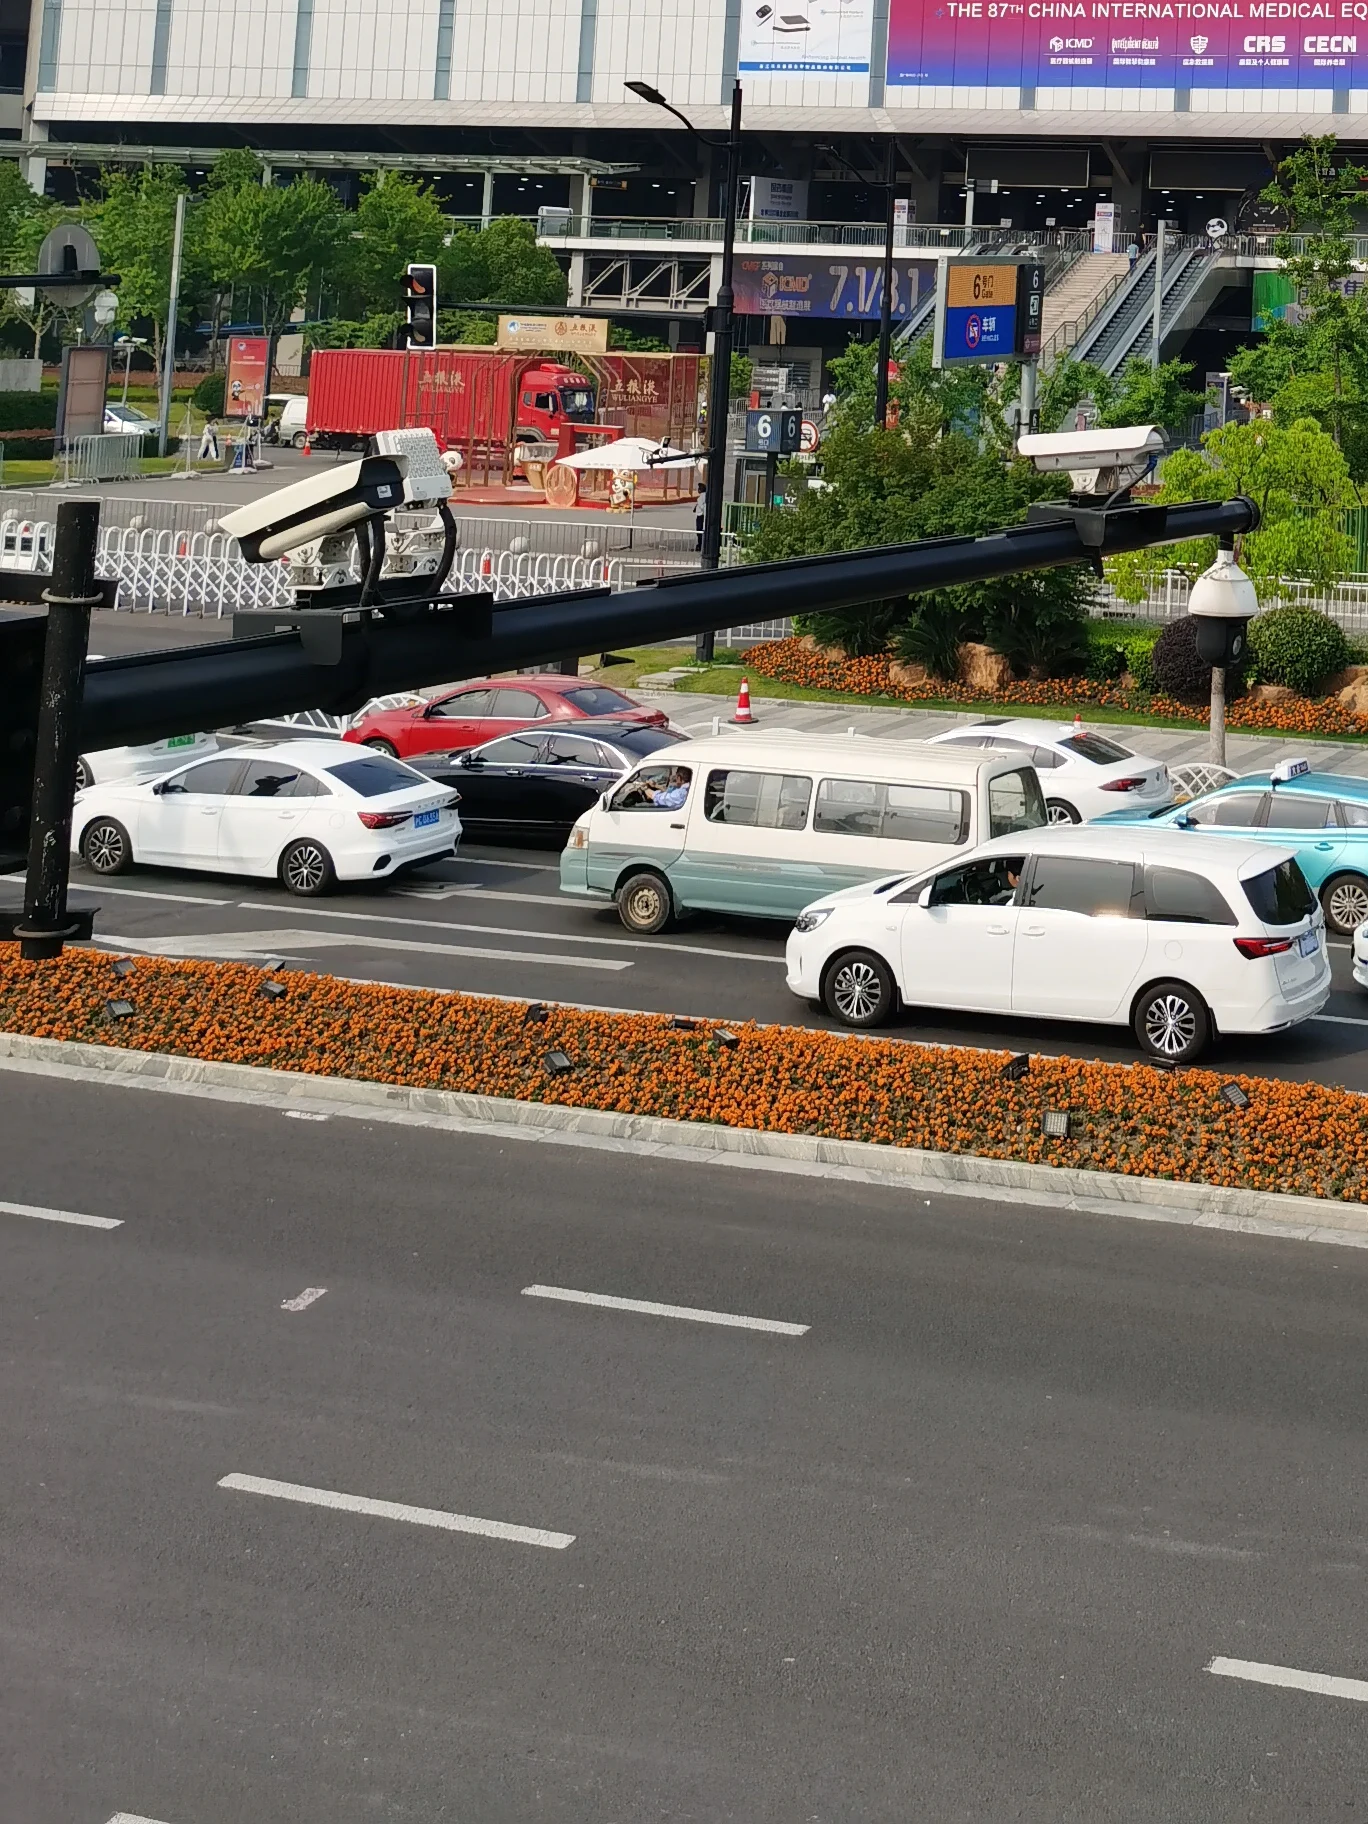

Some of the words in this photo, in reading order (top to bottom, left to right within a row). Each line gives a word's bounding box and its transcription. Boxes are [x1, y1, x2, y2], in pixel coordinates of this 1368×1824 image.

[947, 3, 983, 18] THE
[988, 3, 1024, 18] 87TH
[1028, 3, 1086, 18] CHINA
[1092, 3, 1244, 19] INTERNATIONAL
[1250, 2, 1335, 18] MEDICAL
[1065, 38, 1093, 49] ICMD
[1243, 35, 1286, 53] CRS
[1303, 35, 1357, 53] CECN
[973, 274, 982, 300] 6
[1032, 269, 1040, 289] 6
[611, 393, 658, 403] WULIANGYE
[757, 414, 772, 438] 6
[788, 415, 796, 438] 6
